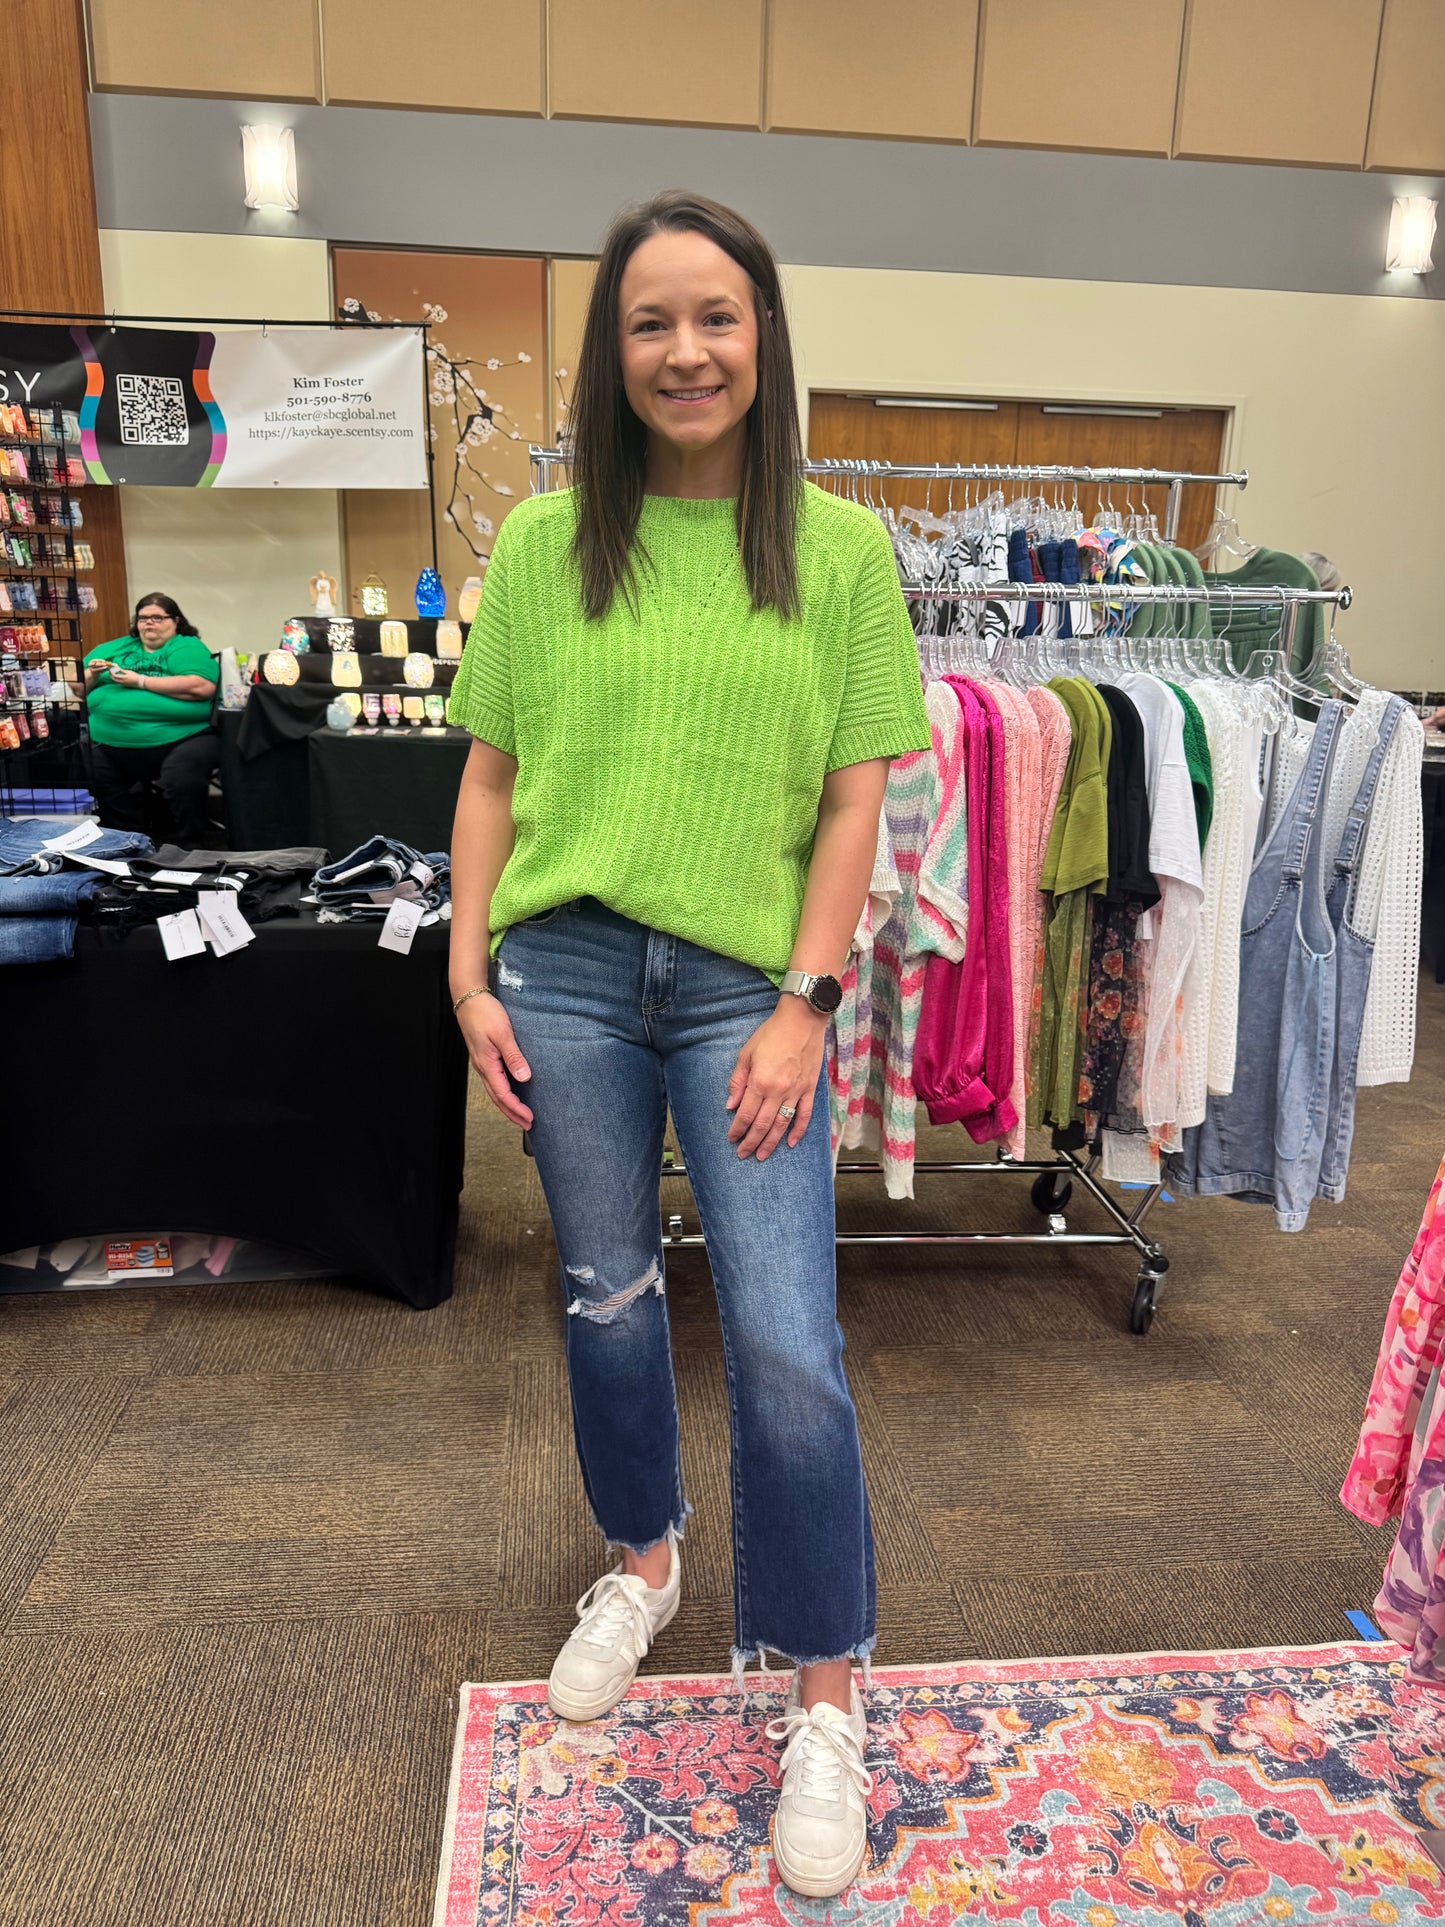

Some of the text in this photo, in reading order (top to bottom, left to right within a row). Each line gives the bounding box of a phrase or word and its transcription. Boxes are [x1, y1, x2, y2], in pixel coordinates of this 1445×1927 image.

[293, 377, 364, 388] Kim Foster
[287, 392, 372, 408] 501-590-8776
[264, 408, 397, 422] klkfoster@sbcglobal.net
[248, 425, 414, 441] https://kayekaye.scentsy.com
